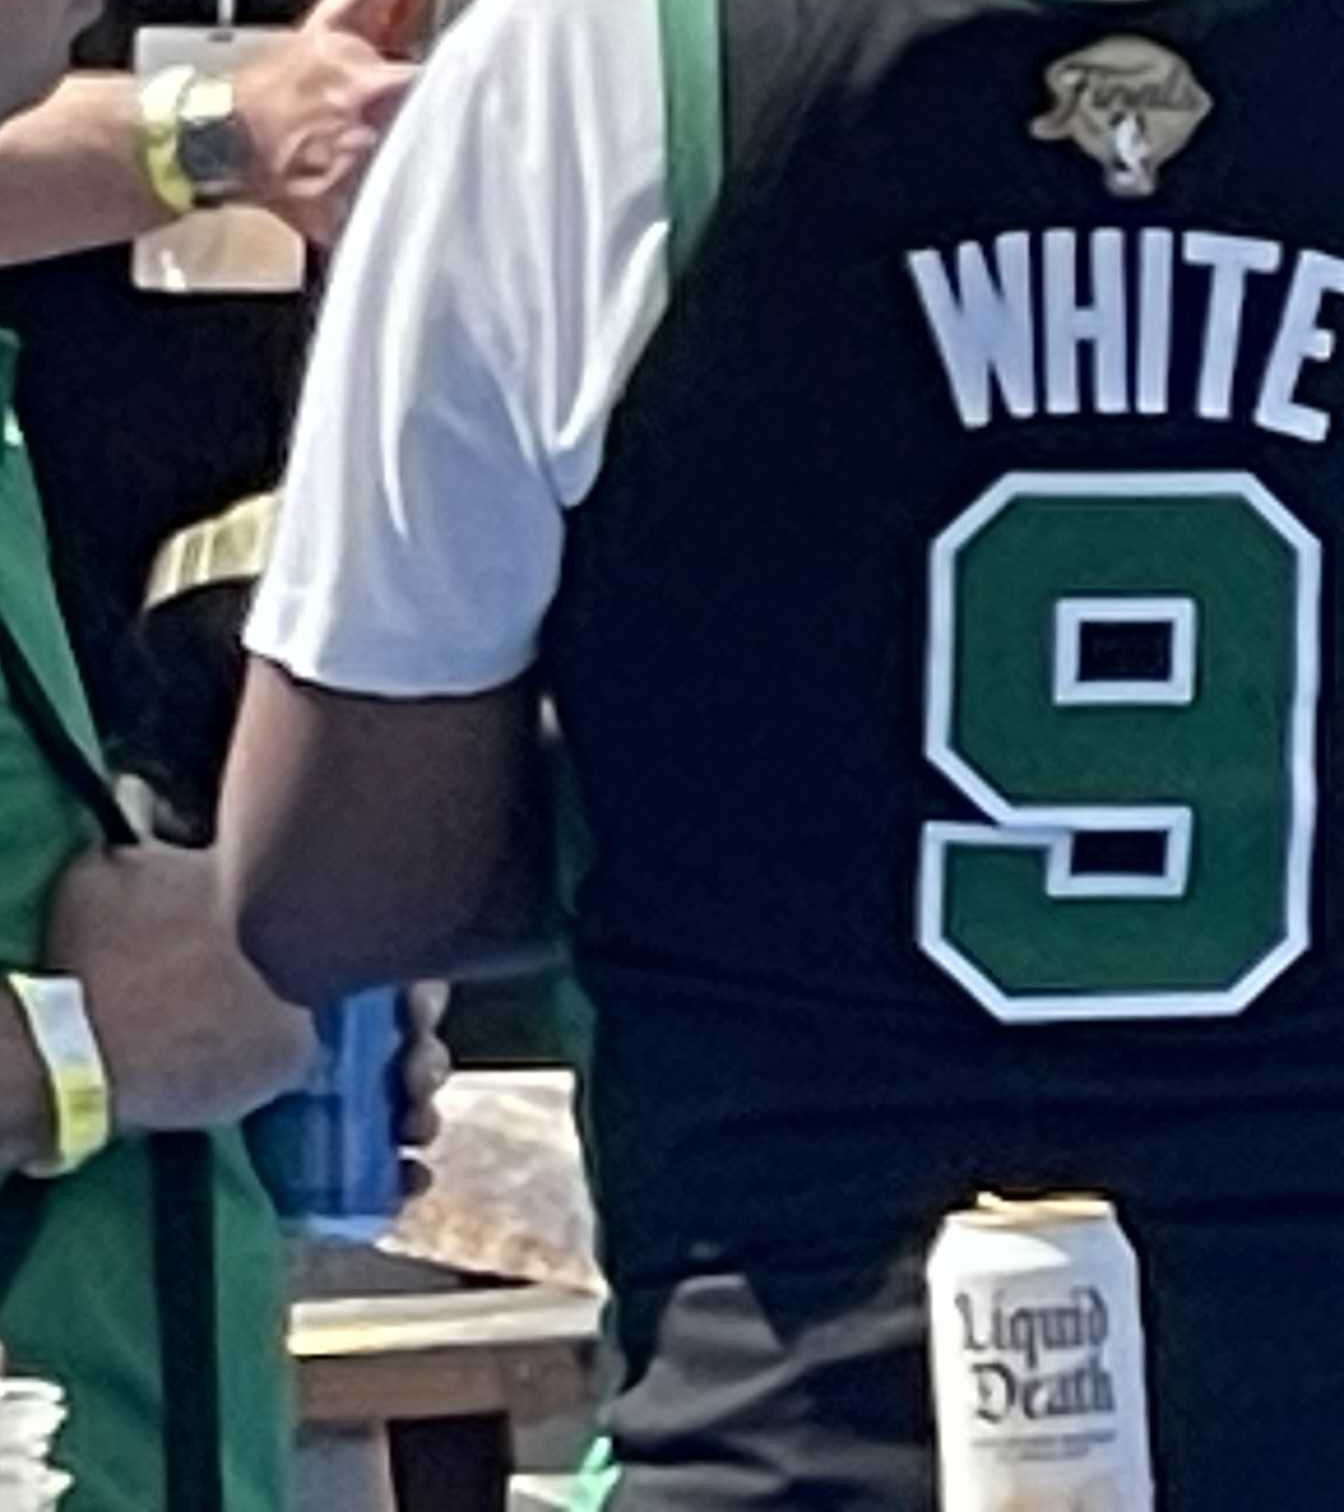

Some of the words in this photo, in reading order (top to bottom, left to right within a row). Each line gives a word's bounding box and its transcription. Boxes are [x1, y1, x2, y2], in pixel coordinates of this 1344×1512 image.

[918, 470, 1323, 1024] 9
[954, 1285, 1111, 1372] Liquid
[969, 1355, 1118, 1424] Death
